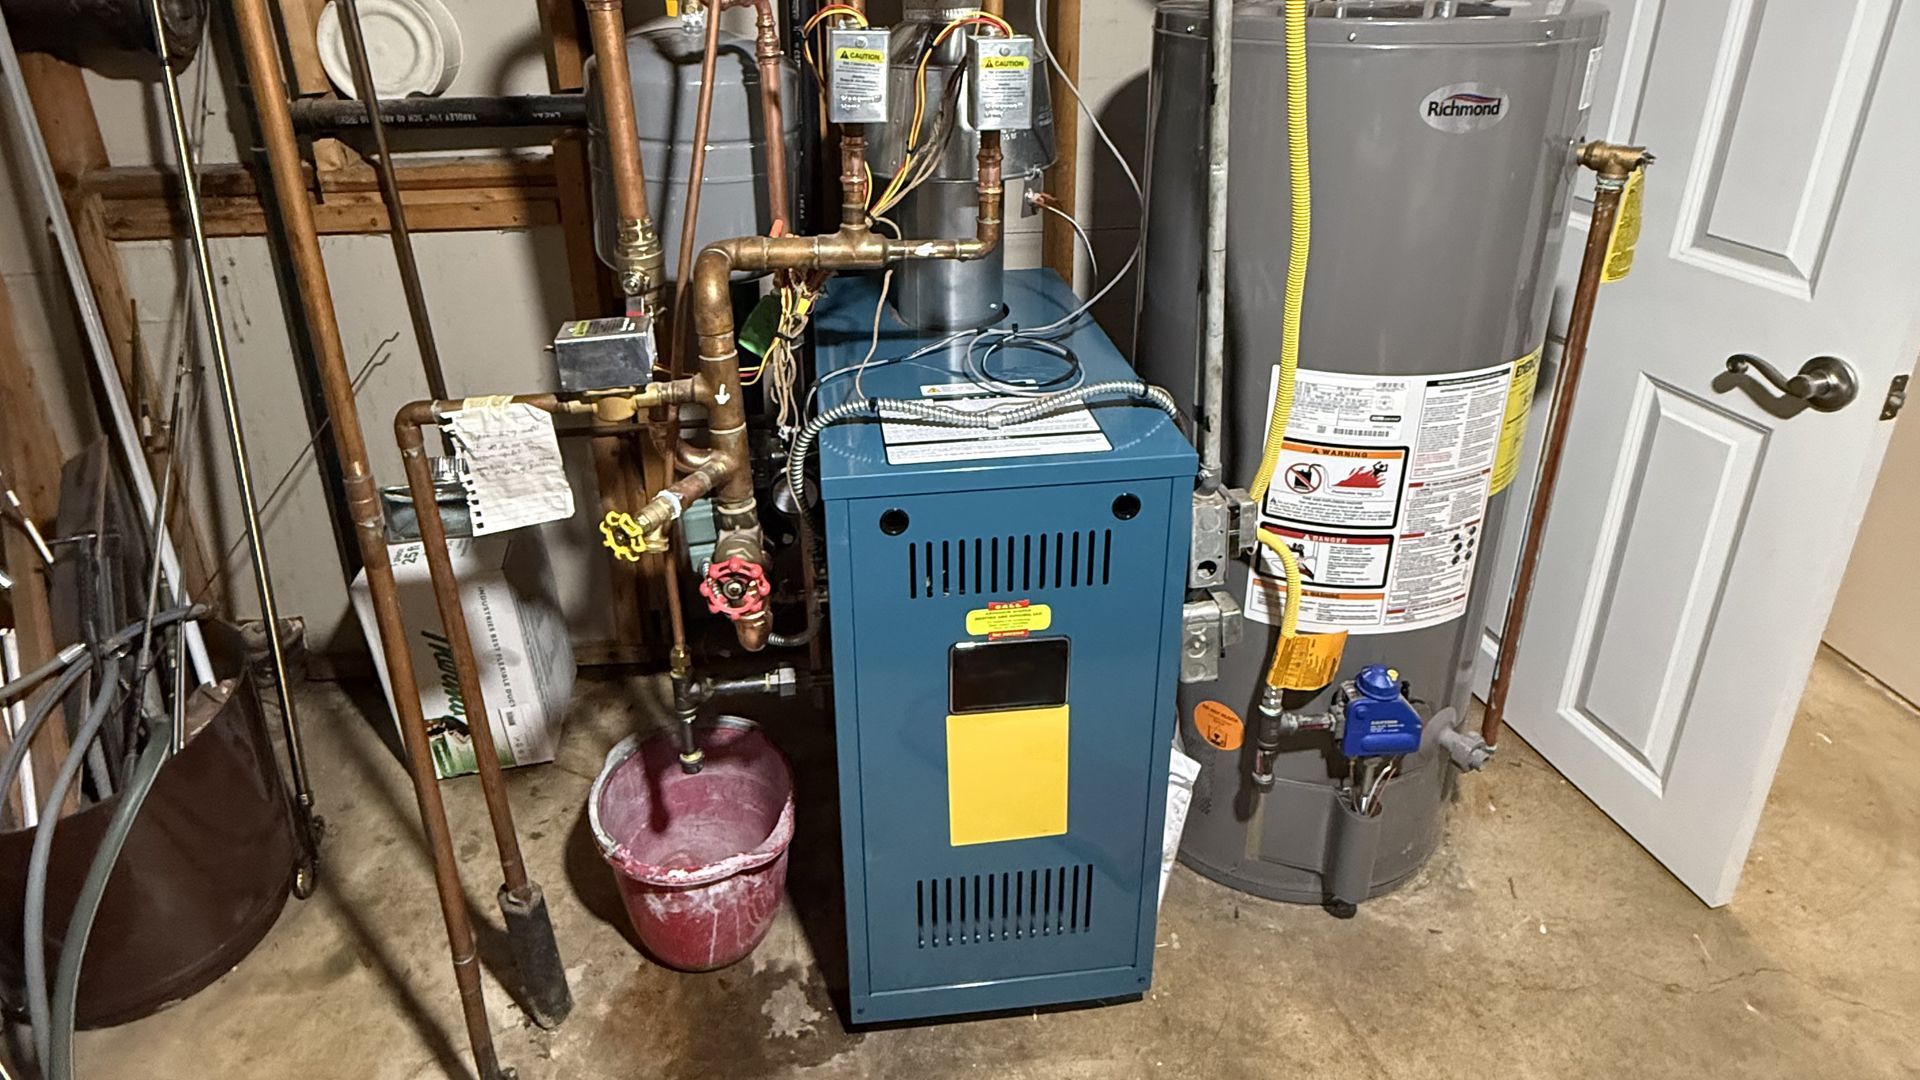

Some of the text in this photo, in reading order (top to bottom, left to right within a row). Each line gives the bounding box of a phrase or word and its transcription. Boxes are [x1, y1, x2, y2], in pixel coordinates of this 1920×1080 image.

[850, 52, 880, 60] CAUTION
[1428, 98, 1501, 116] Richmond
[445, 112, 477, 121] YARDLEY
[1322, 449, 1368, 458] WARNING
[1312, 535, 1348, 544] DANGER
[401, 551, 417, 566] 25
[491, 633, 501, 651] BEST
[496, 653, 510, 687] FLEXIBLE
[506, 688, 516, 708] DUCT
